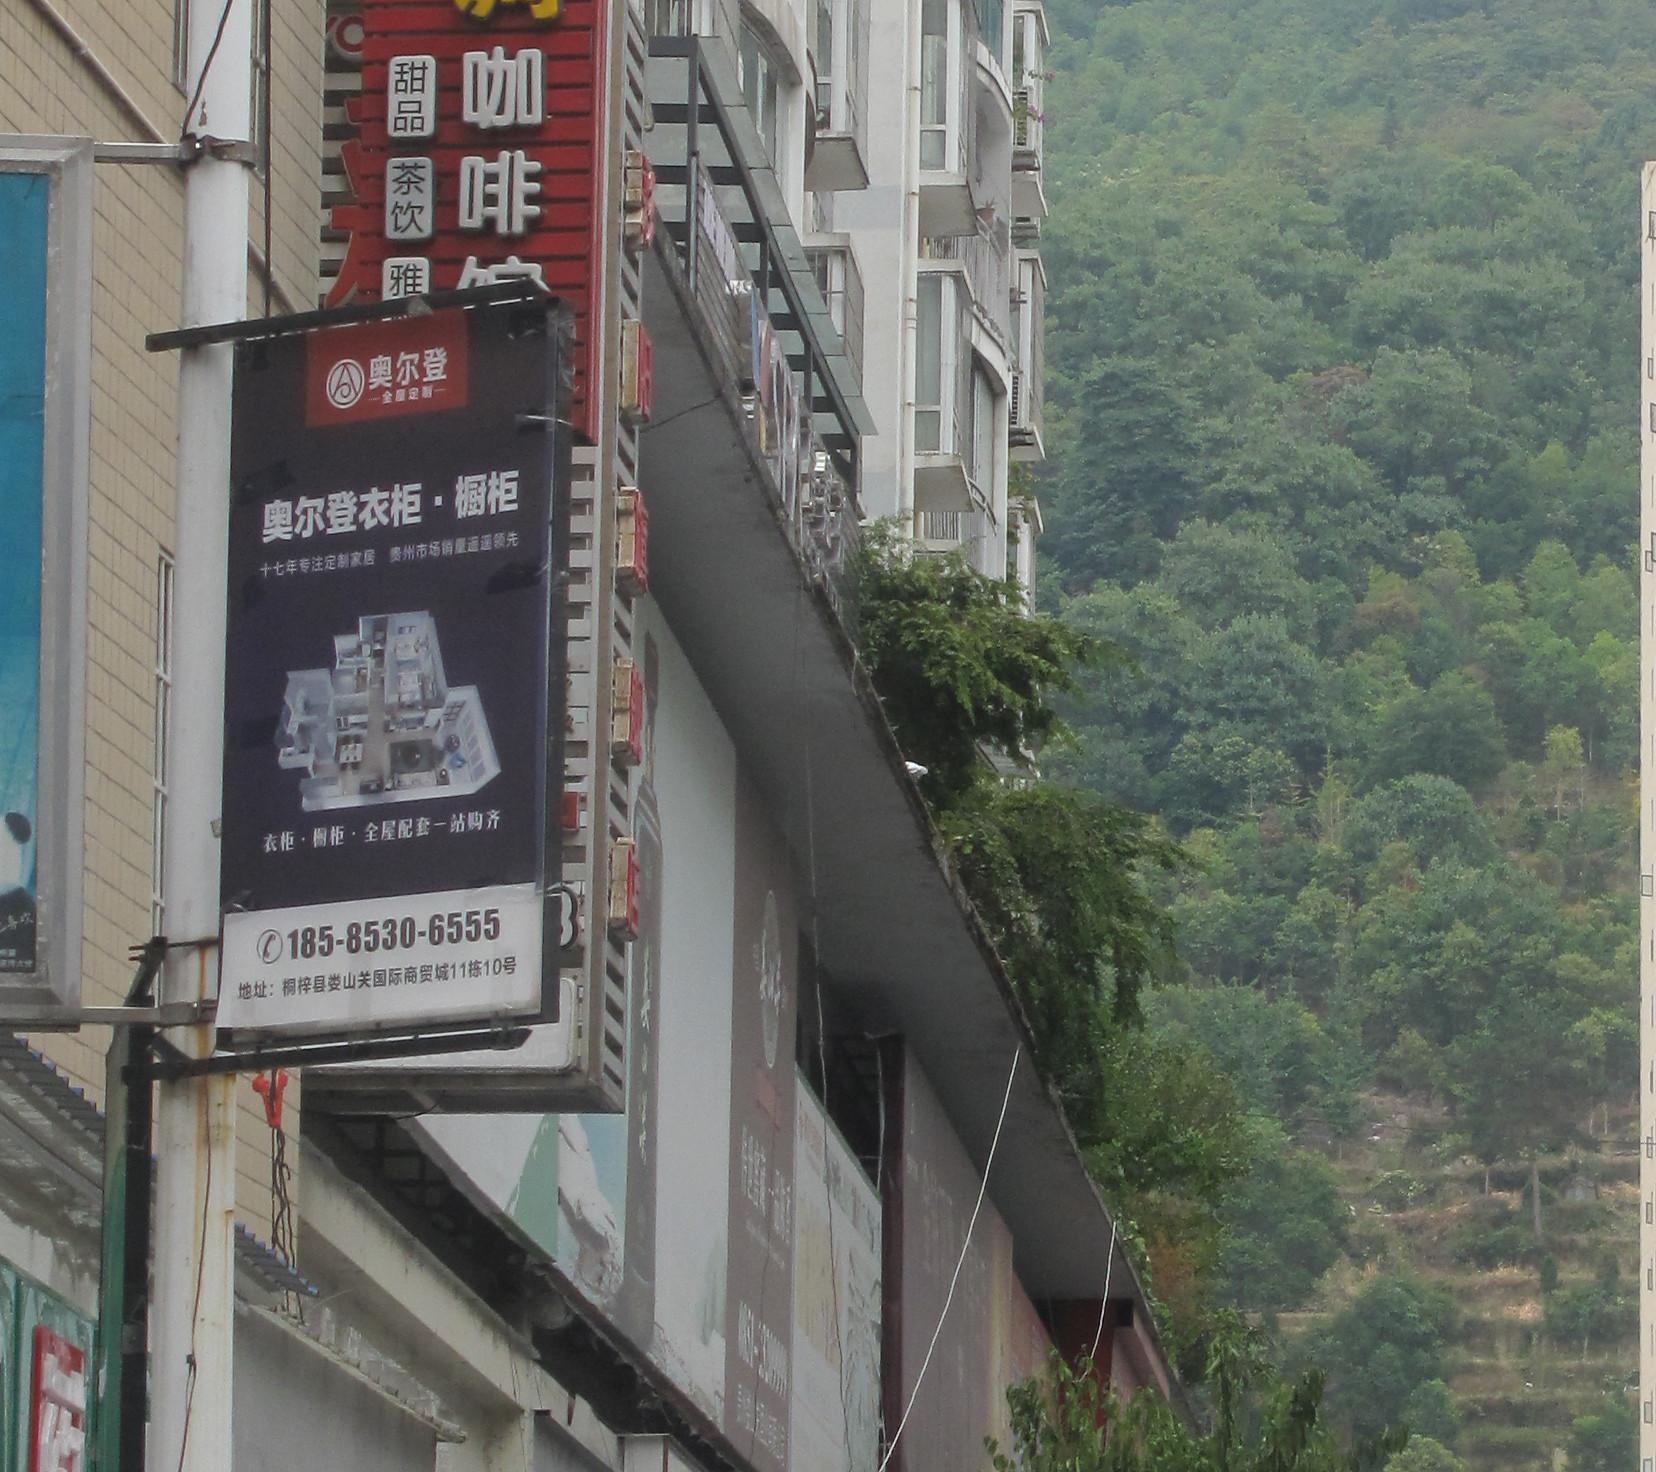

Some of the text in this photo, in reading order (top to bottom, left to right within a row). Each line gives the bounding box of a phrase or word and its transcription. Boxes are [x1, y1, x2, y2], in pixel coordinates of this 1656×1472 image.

[394, 61, 427, 134] 甜品
[391, 164, 425, 235] 茶饮
[367, 347, 448, 390] 奥尔登
[380, 385, 433, 405] 全屋定制
[259, 548, 376, 578] 十七年专注定制家居
[286, 908, 501, 960] 185-8530-6555
